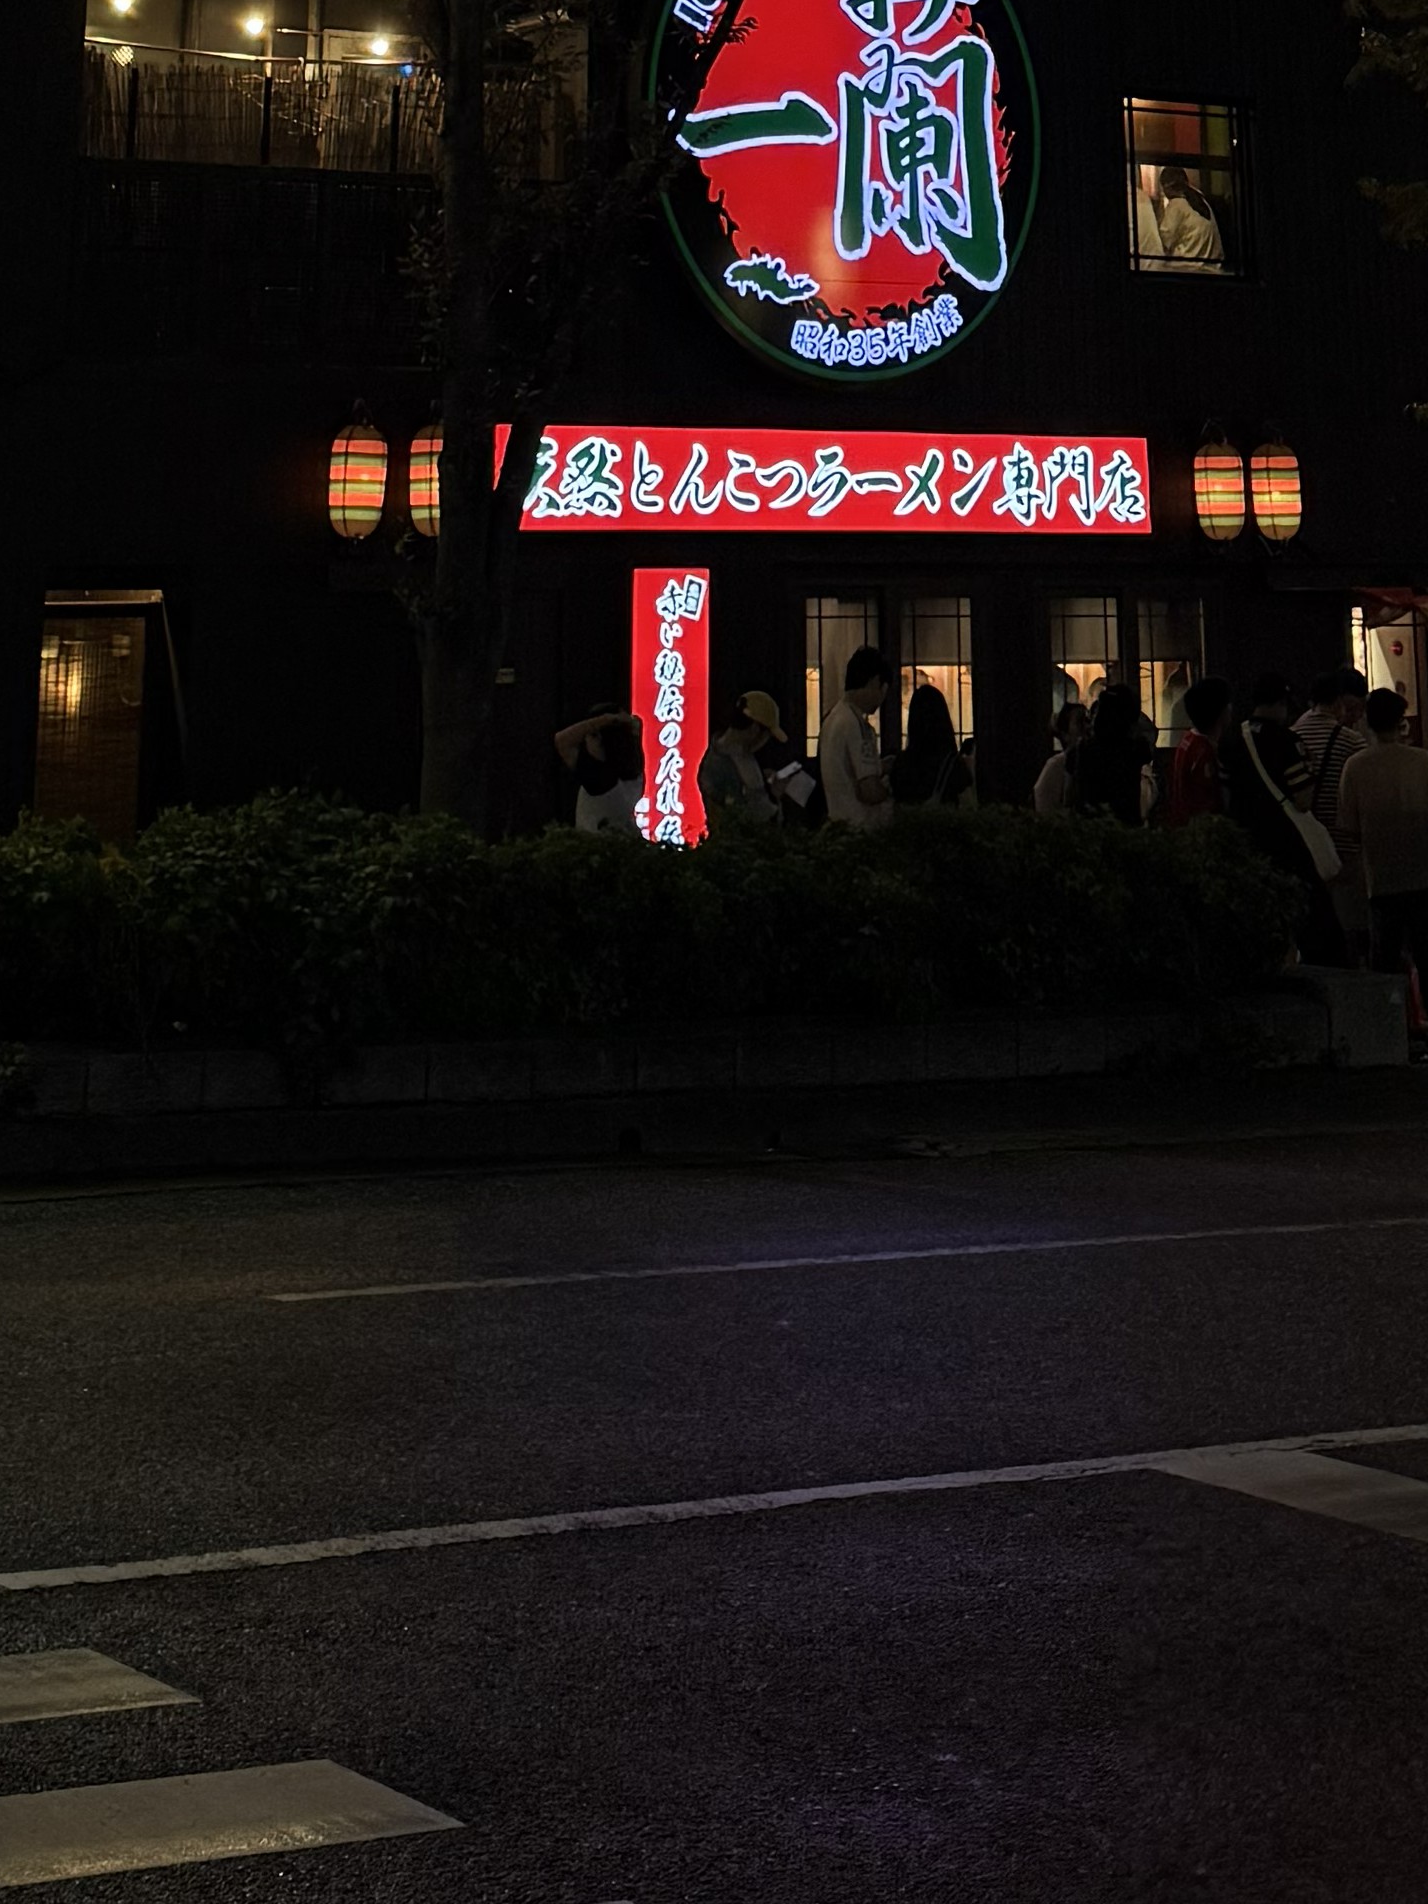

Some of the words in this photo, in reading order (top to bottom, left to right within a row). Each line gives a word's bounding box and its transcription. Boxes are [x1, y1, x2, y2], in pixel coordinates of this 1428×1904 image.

[790, 293, 964, 367] 昭和35年創業
